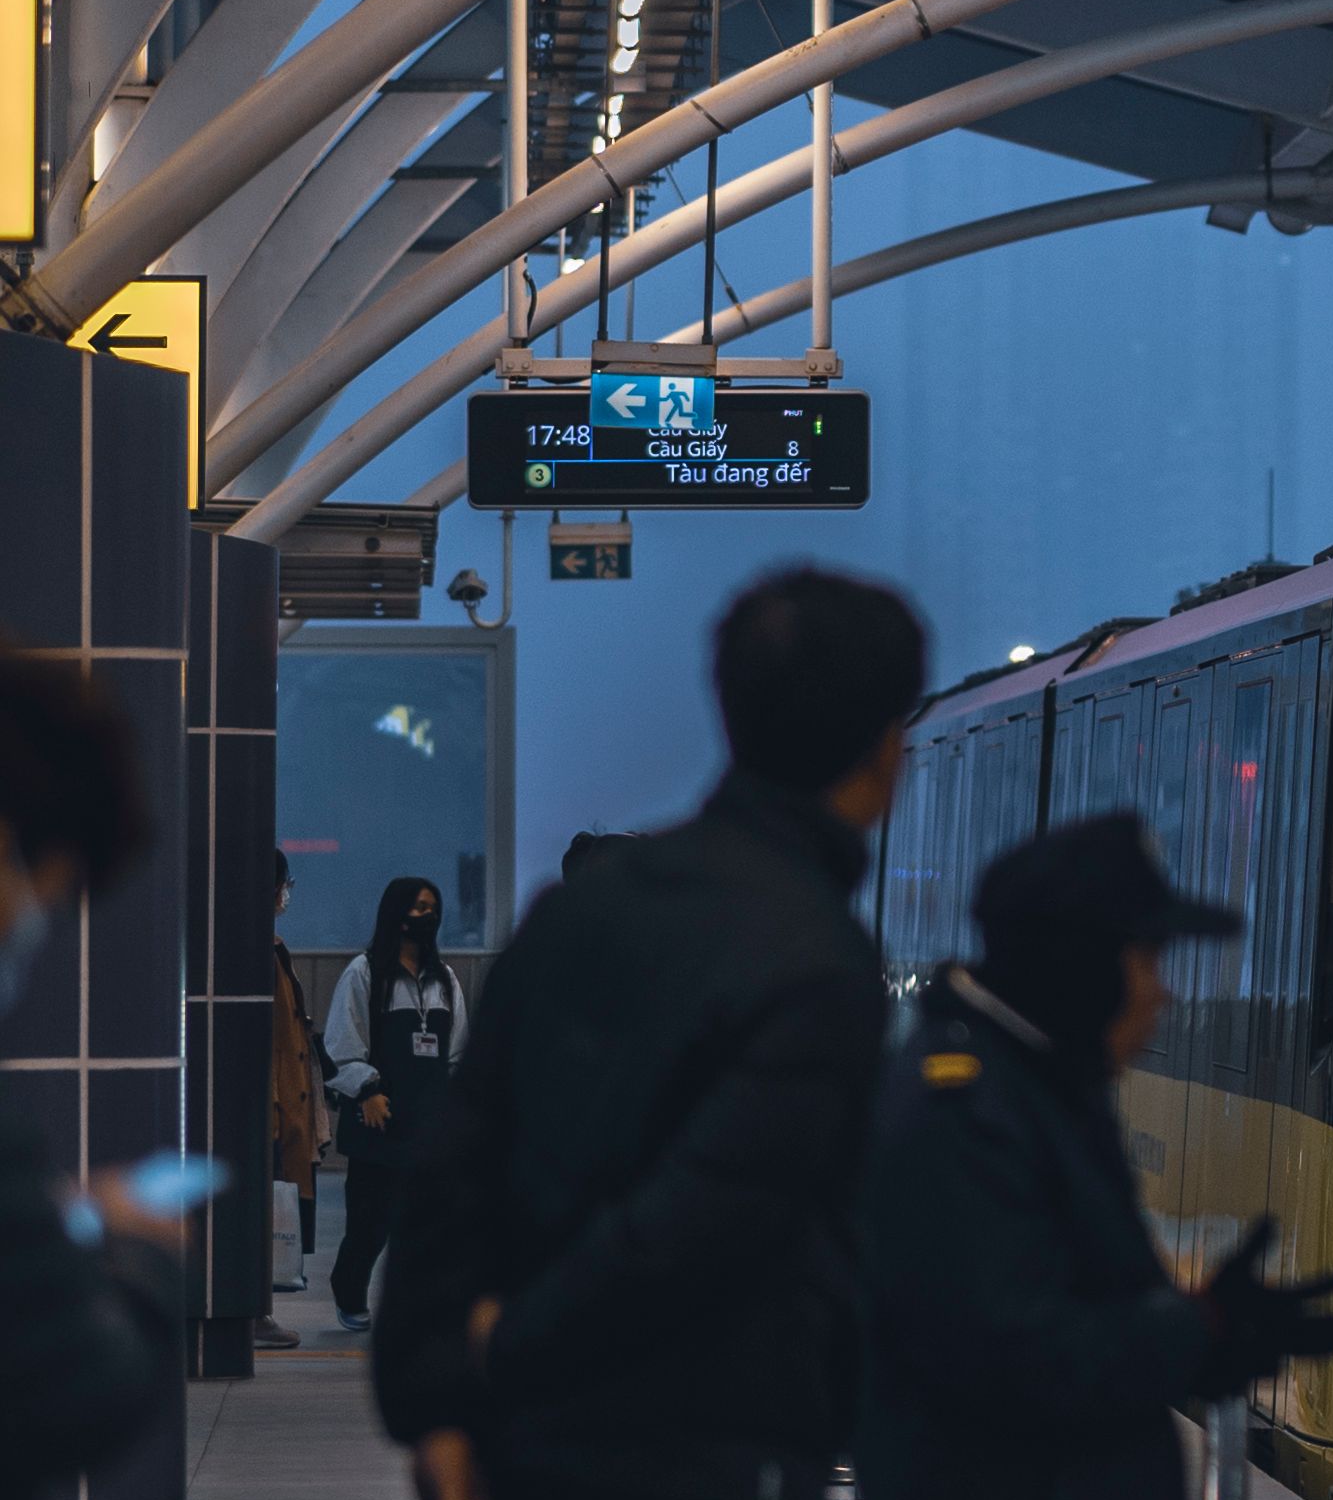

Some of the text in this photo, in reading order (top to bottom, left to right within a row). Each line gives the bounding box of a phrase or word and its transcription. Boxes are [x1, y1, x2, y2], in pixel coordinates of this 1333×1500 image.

[527, 425, 591, 446] 17:48
[647, 438, 727, 461] Cầu Giấy
[788, 441, 799, 457] 8
[535, 468, 545, 482] 3
[666, 462, 707, 484] Tàu
[714, 463, 769, 487] đang
